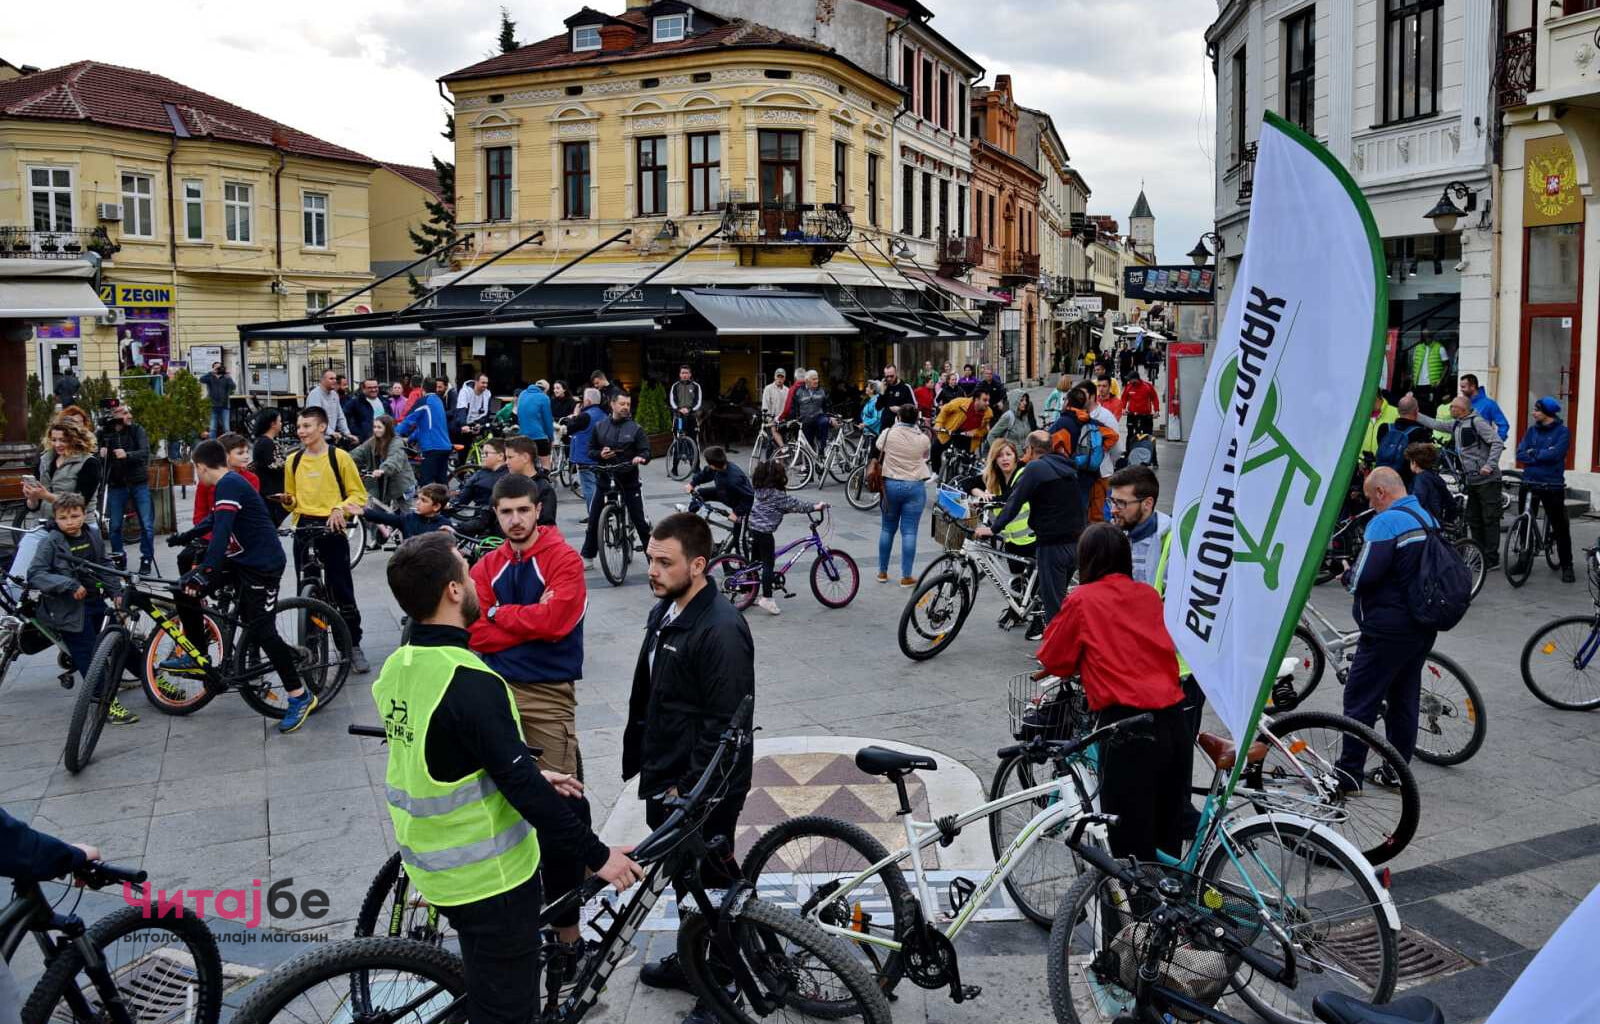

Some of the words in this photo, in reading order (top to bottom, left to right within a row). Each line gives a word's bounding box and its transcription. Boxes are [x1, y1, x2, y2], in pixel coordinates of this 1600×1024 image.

[121, 288, 171, 303] ZEGIN
[151, 604, 209, 667] TREK
[574, 862, 671, 1008] TREK
